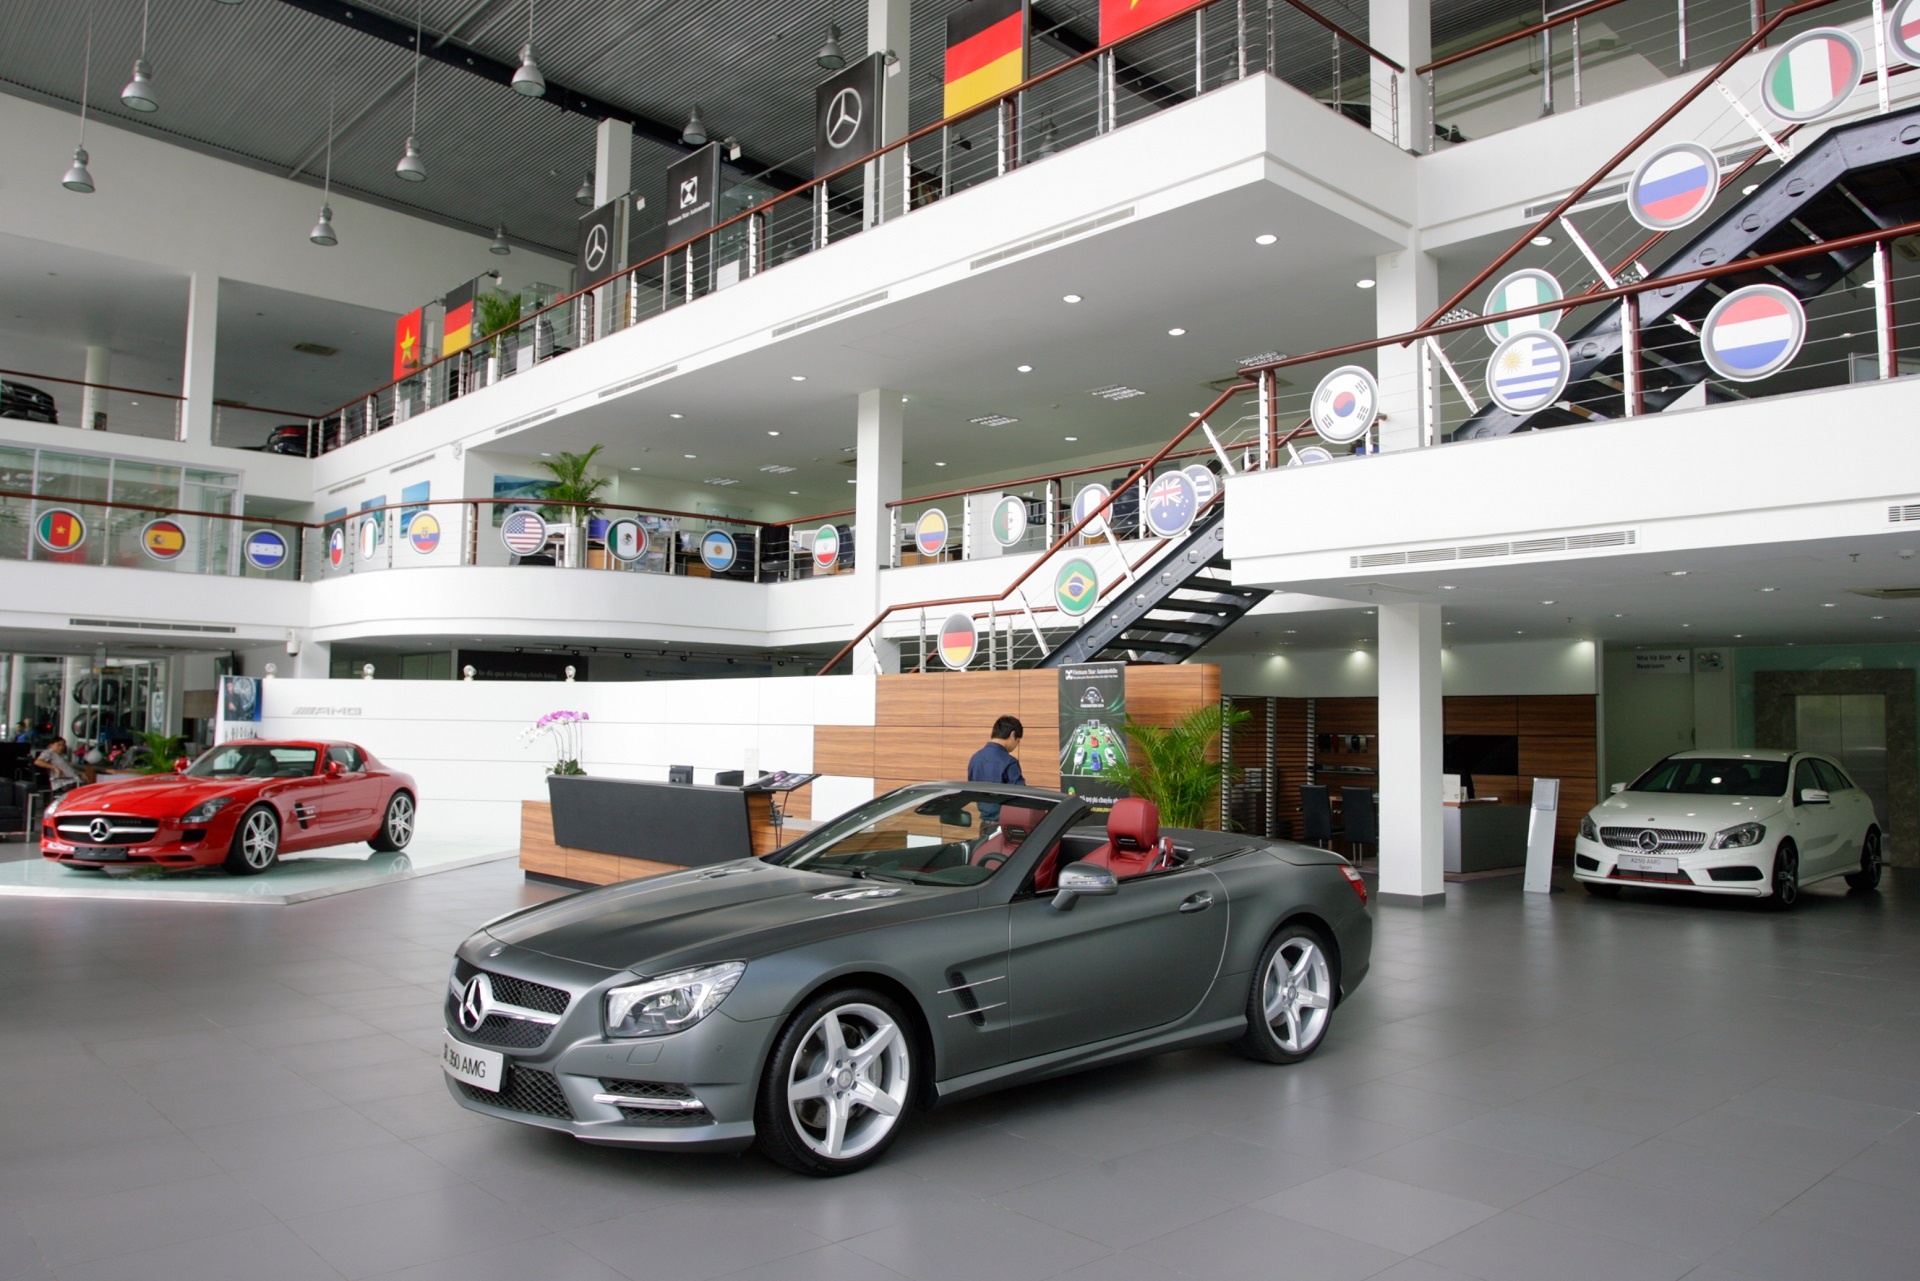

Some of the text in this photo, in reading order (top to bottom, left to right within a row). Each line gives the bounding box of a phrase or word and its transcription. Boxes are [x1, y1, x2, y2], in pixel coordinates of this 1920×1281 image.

[314, 706, 362, 716] AMG
[449, 1049, 460, 1070] 350
[461, 1056, 487, 1079] AMG
